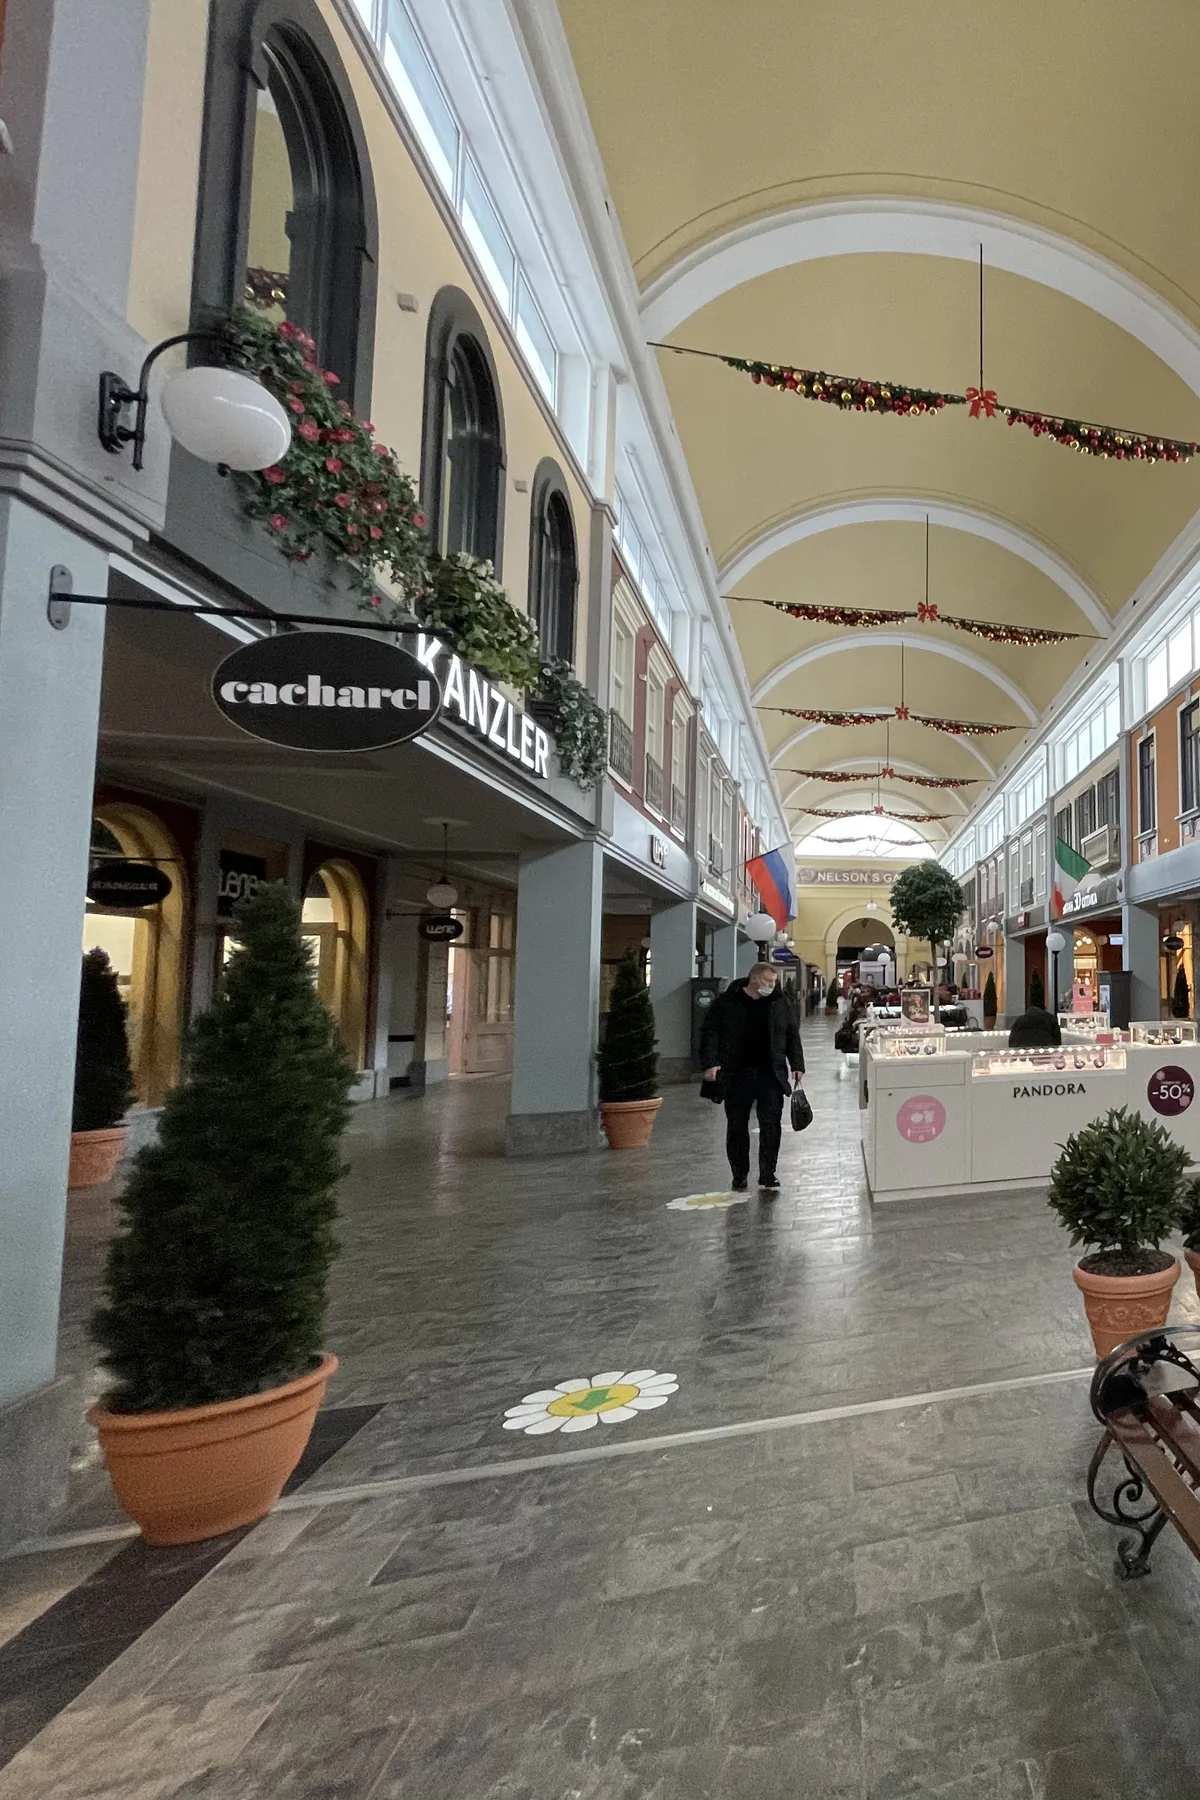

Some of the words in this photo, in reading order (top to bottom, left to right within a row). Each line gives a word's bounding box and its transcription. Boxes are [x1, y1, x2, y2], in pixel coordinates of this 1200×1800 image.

[220, 674, 431, 710] cacharel
[417, 623, 549, 779] KANZLER
[817, 871, 880, 883] NELSON'S
[1012, 1082, 1087, 1099] PANDORA
[1151, 1083, 1191, 1100] -50%
